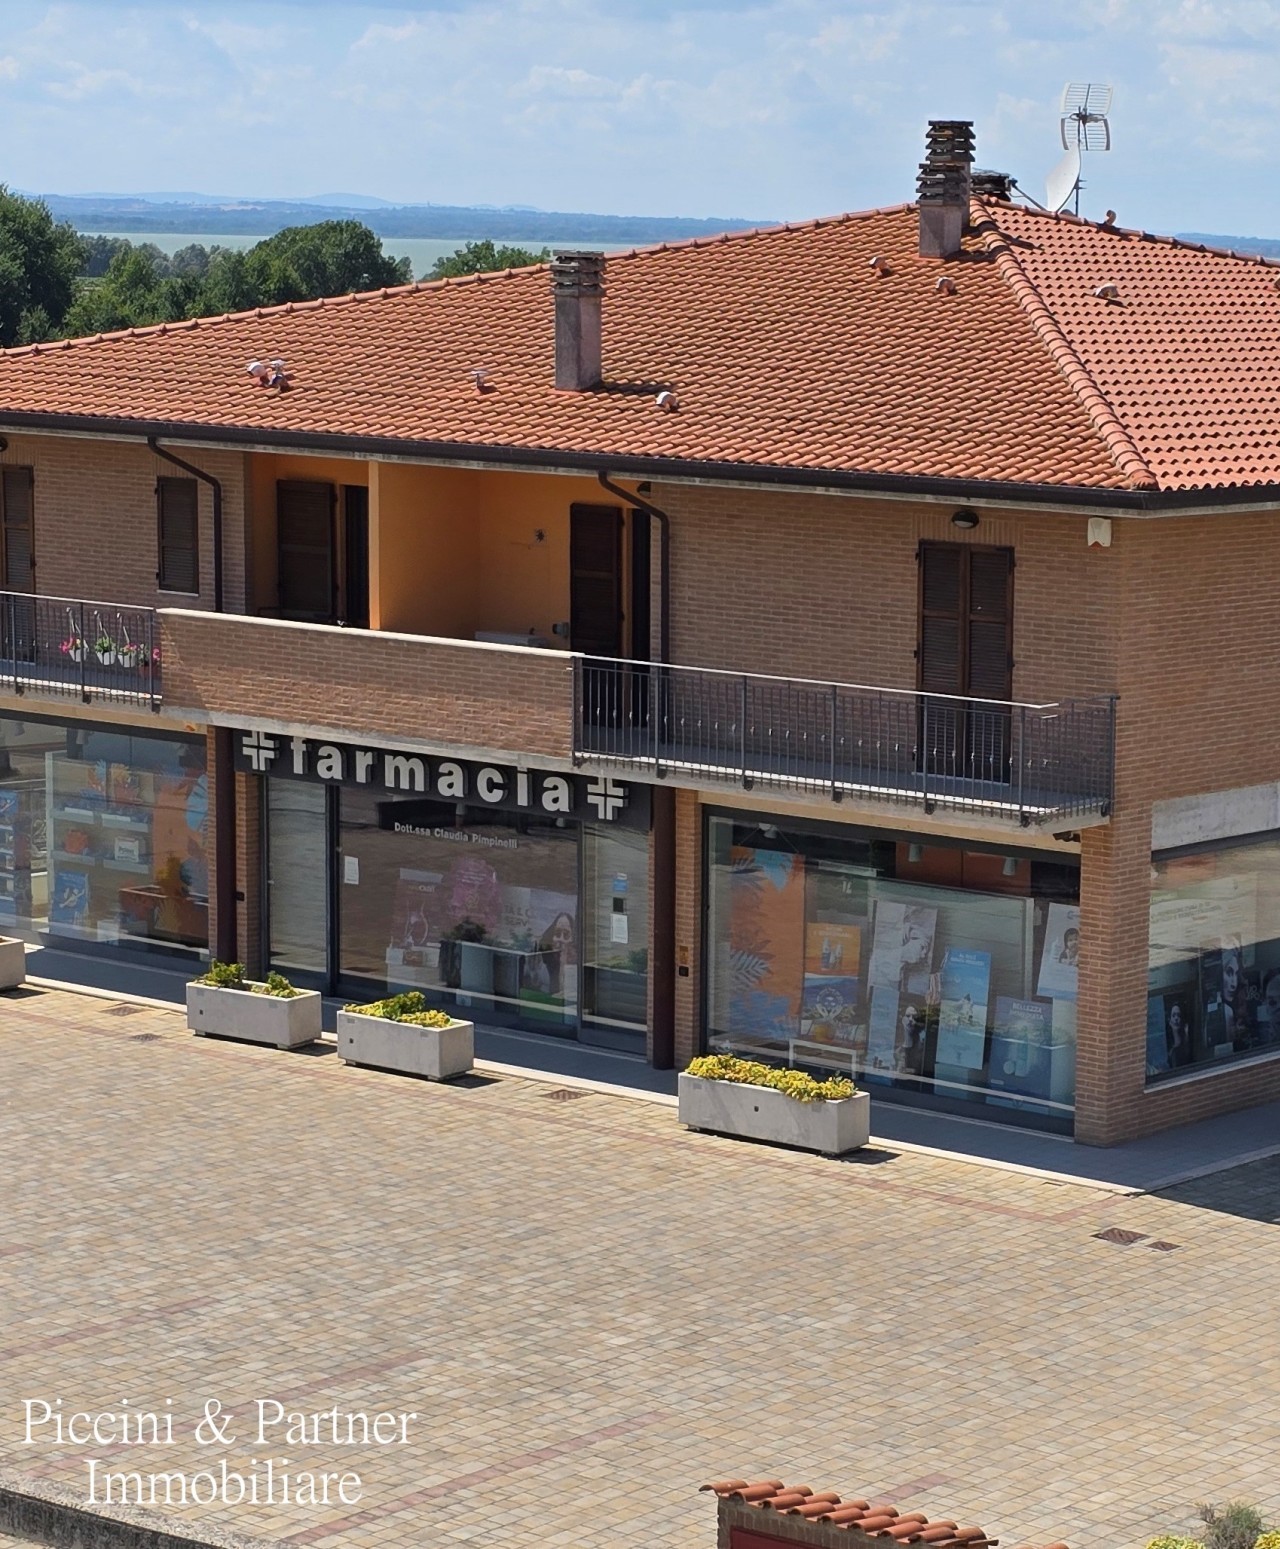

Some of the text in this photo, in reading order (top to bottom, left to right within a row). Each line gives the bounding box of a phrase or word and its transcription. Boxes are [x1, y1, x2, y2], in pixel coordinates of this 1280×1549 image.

[290, 736, 573, 813] farmacia
[394, 822, 431, 837] Dott.ssa
[434, 827, 469, 842] Claudia
